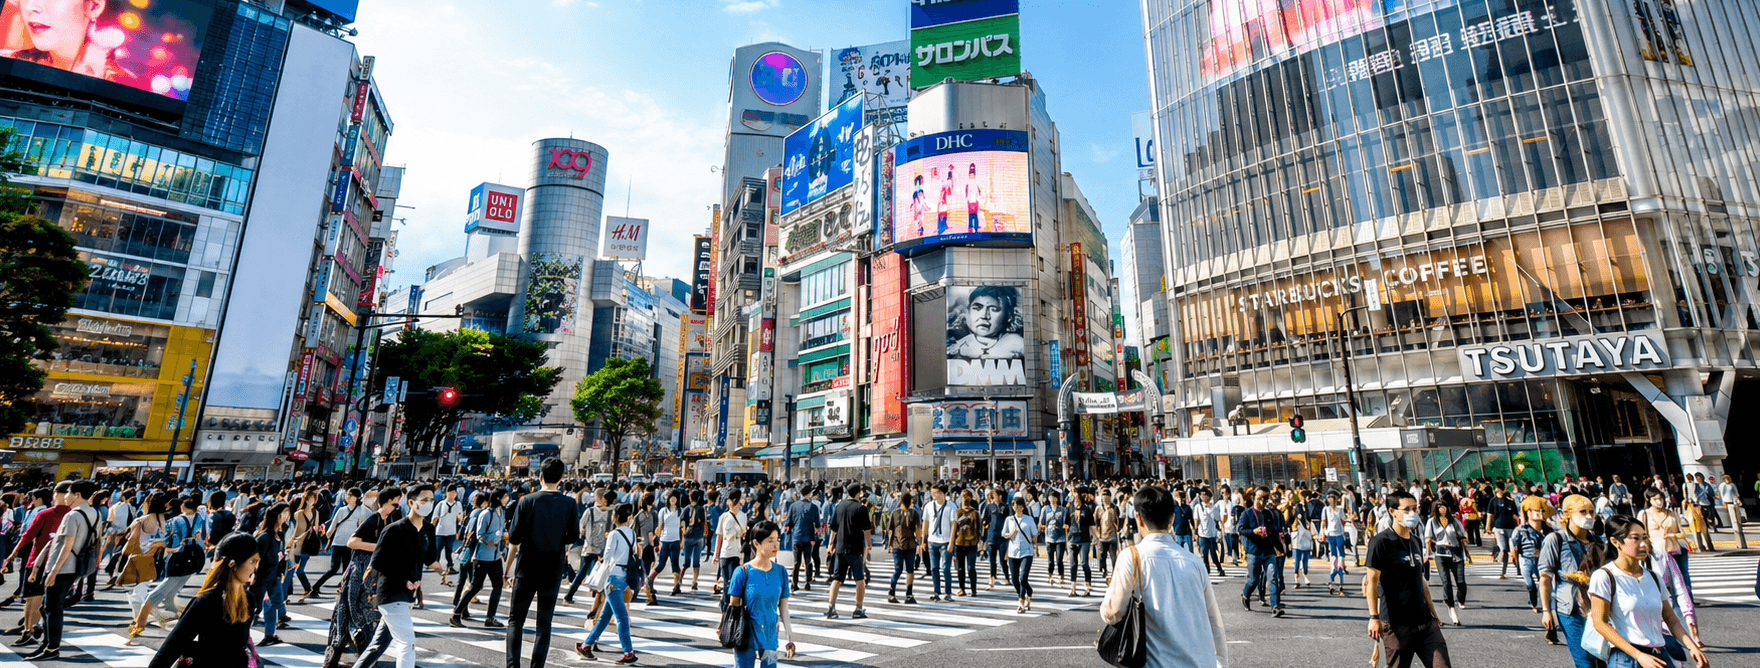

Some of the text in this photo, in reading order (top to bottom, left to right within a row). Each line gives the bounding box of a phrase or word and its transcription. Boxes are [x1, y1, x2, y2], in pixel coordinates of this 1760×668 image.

[915, 33, 1013, 66] サロンパス
[936, 133, 973, 150] DHC
[548, 147, 592, 179] 109
[491, 194, 513, 208] UNI
[1238, 254, 1487, 313] STARBUCKS COFFEE
[1464, 334, 1664, 377] TSUTAYA
[947, 358, 1027, 386] DMM
